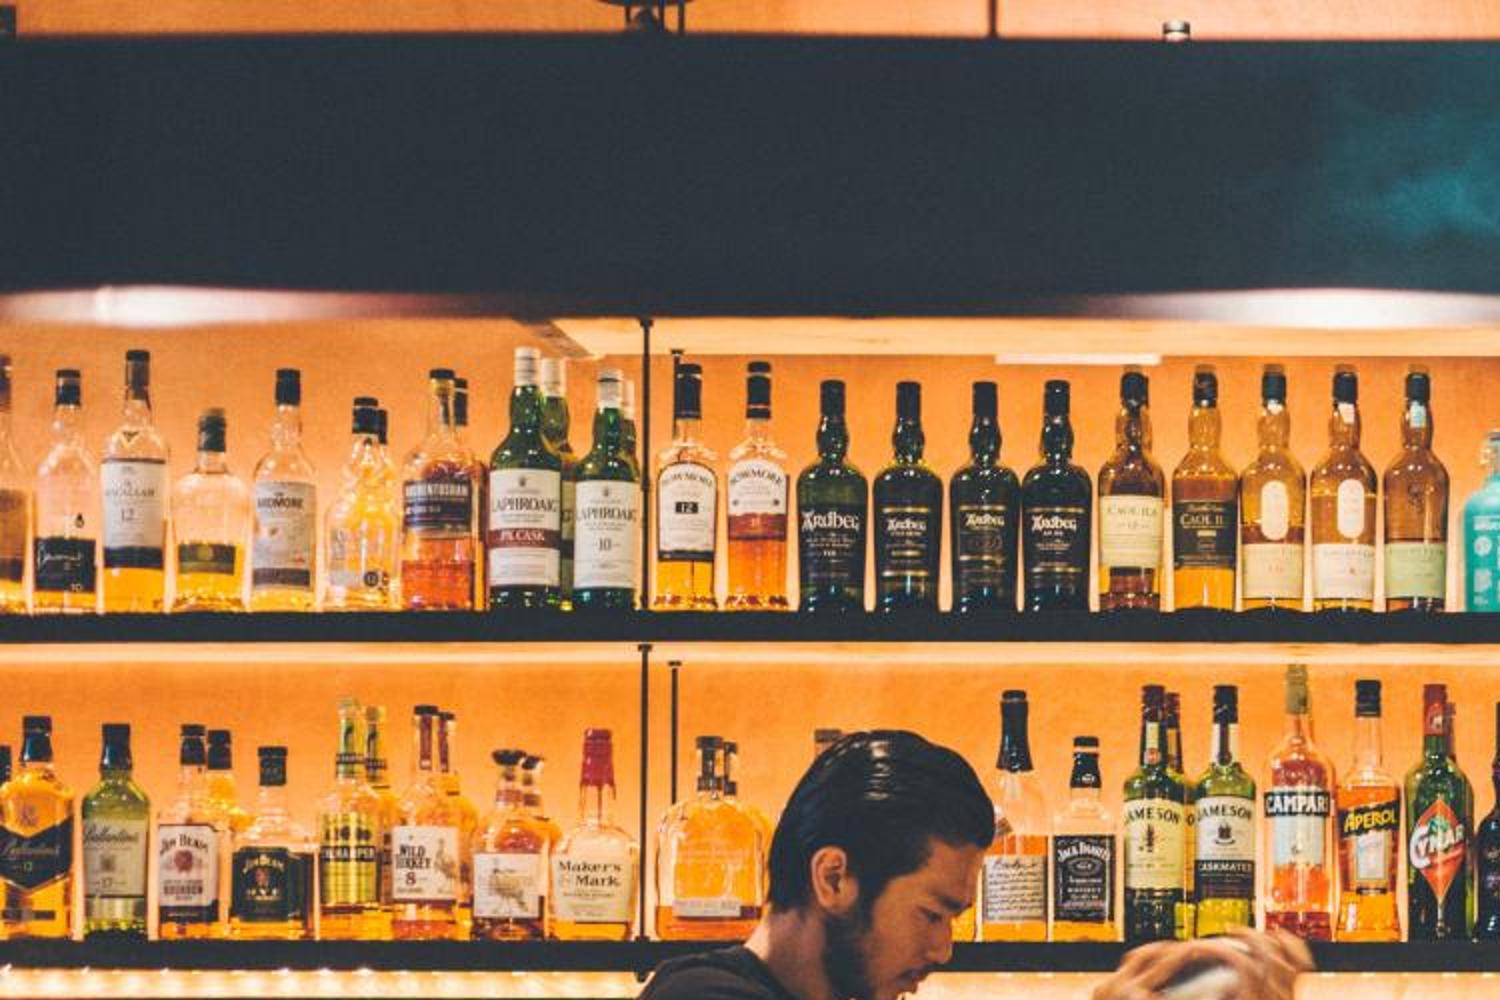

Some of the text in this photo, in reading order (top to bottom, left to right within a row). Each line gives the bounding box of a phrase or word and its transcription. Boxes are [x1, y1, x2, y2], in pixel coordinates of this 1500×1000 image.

[1196, 804, 1253, 823] JAMESON
[1267, 794, 1331, 816] CAMPARI
[1124, 806, 1181, 826] JAMESON
[1343, 809, 1396, 834] APEROL
[400, 845, 426, 858] WILD
[575, 873, 621, 888] Mark
